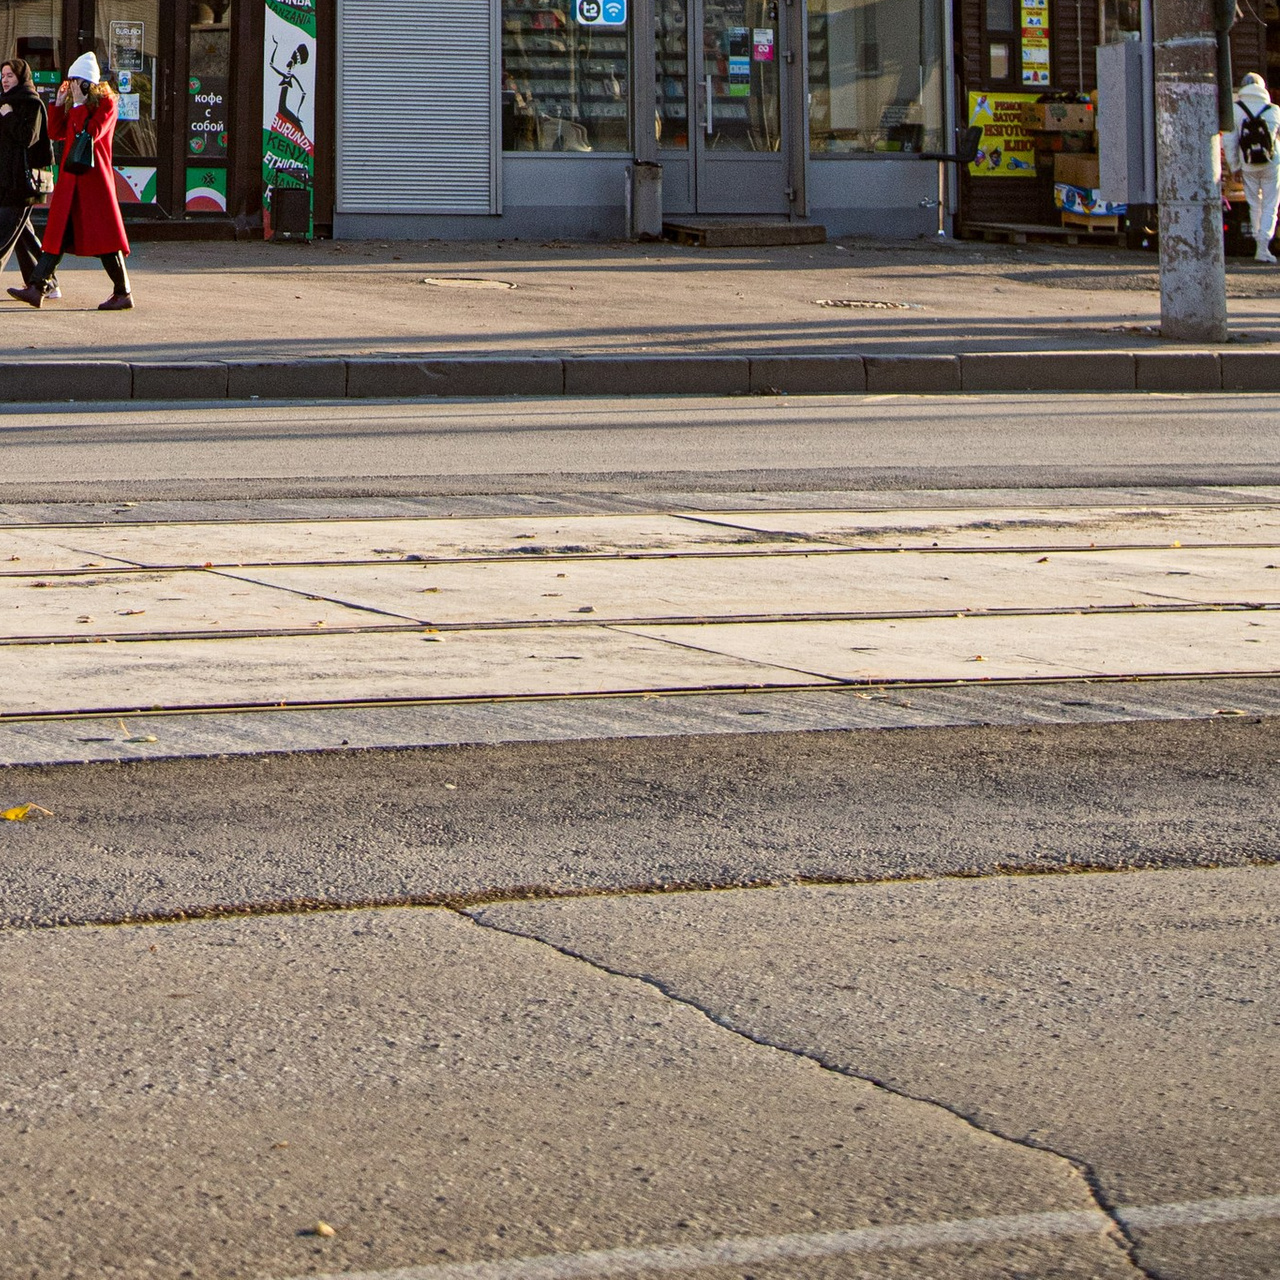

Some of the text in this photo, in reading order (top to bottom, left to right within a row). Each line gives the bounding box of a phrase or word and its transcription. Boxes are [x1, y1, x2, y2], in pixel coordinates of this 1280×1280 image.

[194, 92, 223, 106] кофе
[205, 109, 211, 117] с
[191, 120, 224, 131] собой
